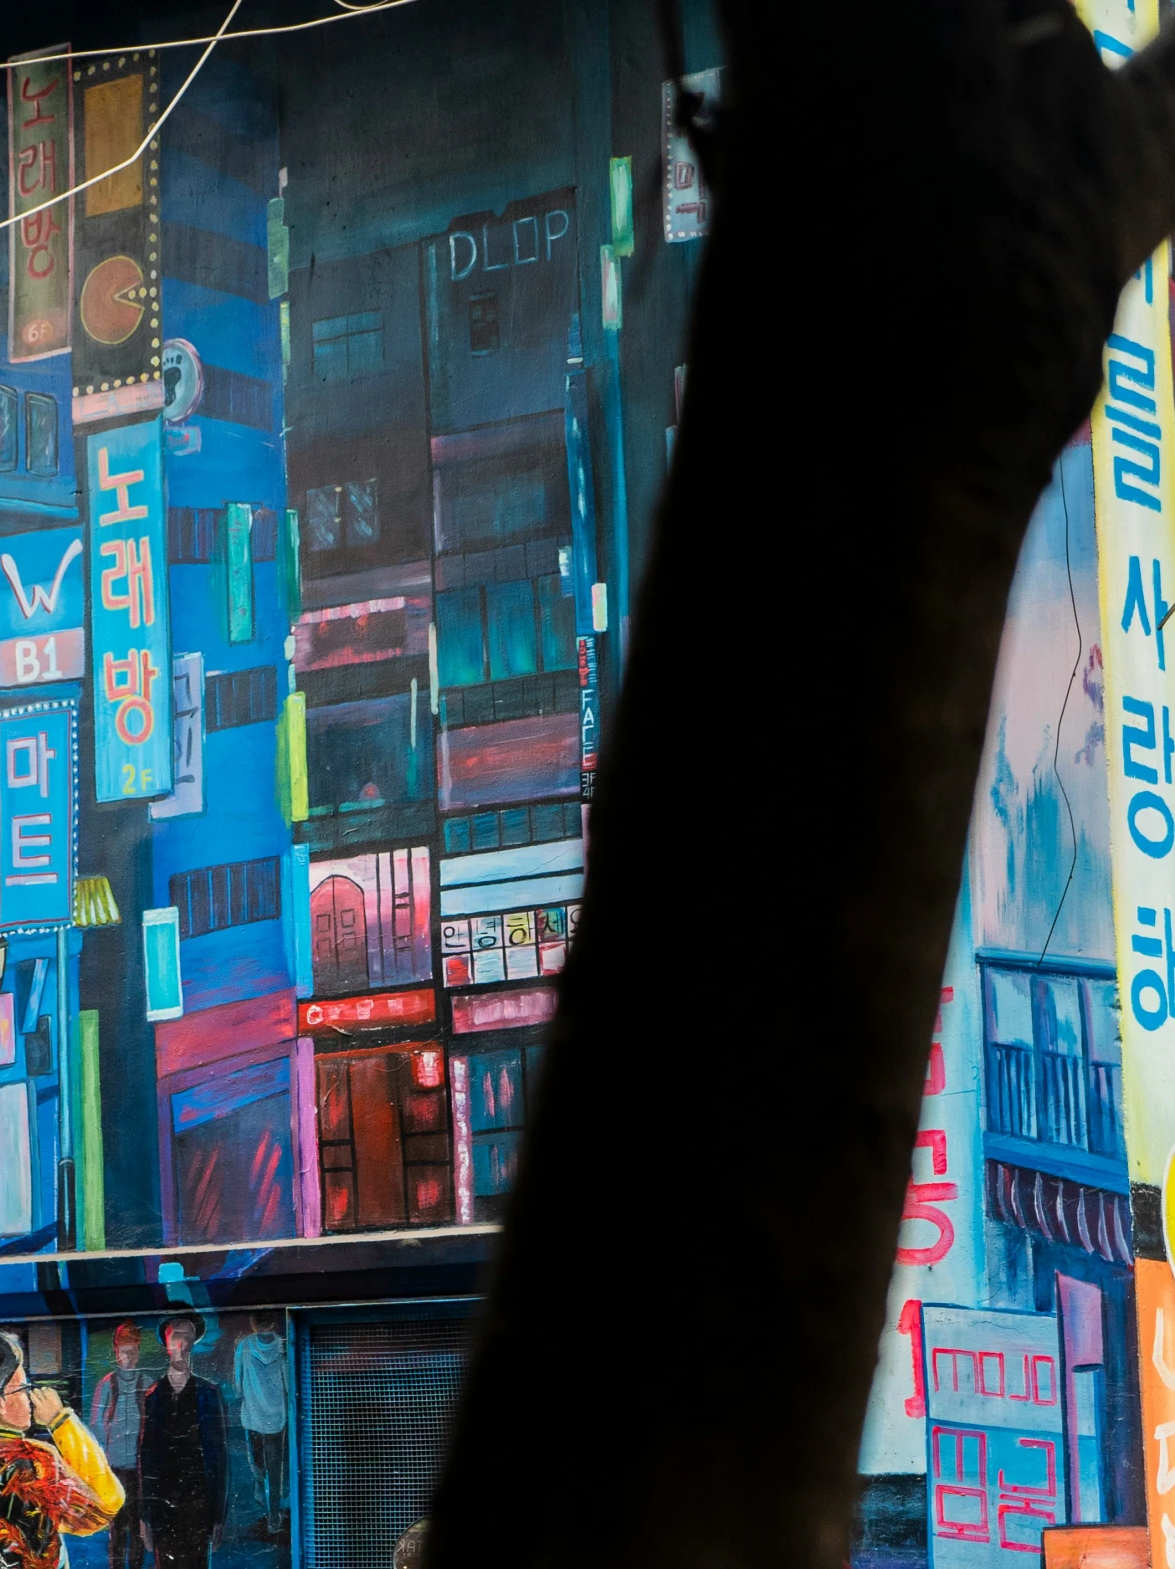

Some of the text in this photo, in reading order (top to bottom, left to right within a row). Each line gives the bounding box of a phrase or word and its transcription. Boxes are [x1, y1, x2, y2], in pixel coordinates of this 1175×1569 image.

[18, 77, 61, 280] 노래방
[0, 539, 83, 619] W
[98, 447, 160, 745] 노래방
[15, 635, 63, 683] B1
[4, 731, 58, 887] 마트
[122, 763, 153, 794] 2F
